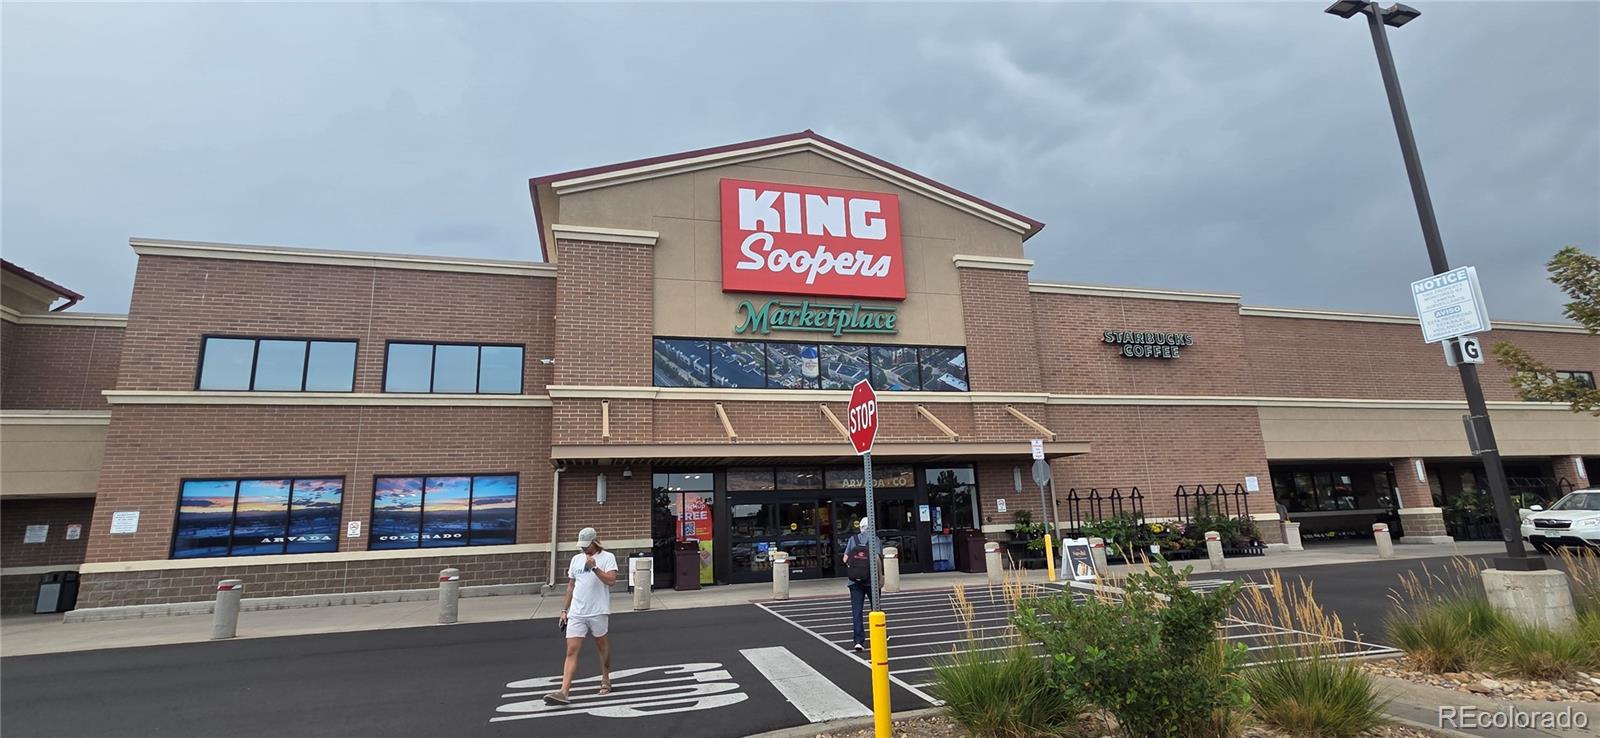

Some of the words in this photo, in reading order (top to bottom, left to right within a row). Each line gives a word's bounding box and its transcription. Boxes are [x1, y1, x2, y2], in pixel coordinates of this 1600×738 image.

[738, 188, 887, 240] KING
[736, 232, 892, 285] Soopers
[1414, 270, 1467, 293] NOTICE
[735, 299, 898, 337] Marketplace
[1435, 306, 1461, 318] AVISO
[1104, 330, 1194, 346] STARBUCKS
[1123, 344, 1180, 358] COFFEE
[1465, 341, 1479, 359] G
[850, 400, 875, 434] STOP
[842, 478, 885, 488] ARVDA
[892, 477, 907, 487] CO
[678, 511, 708, 521] FREE
[261, 535, 332, 543] ARVADA
